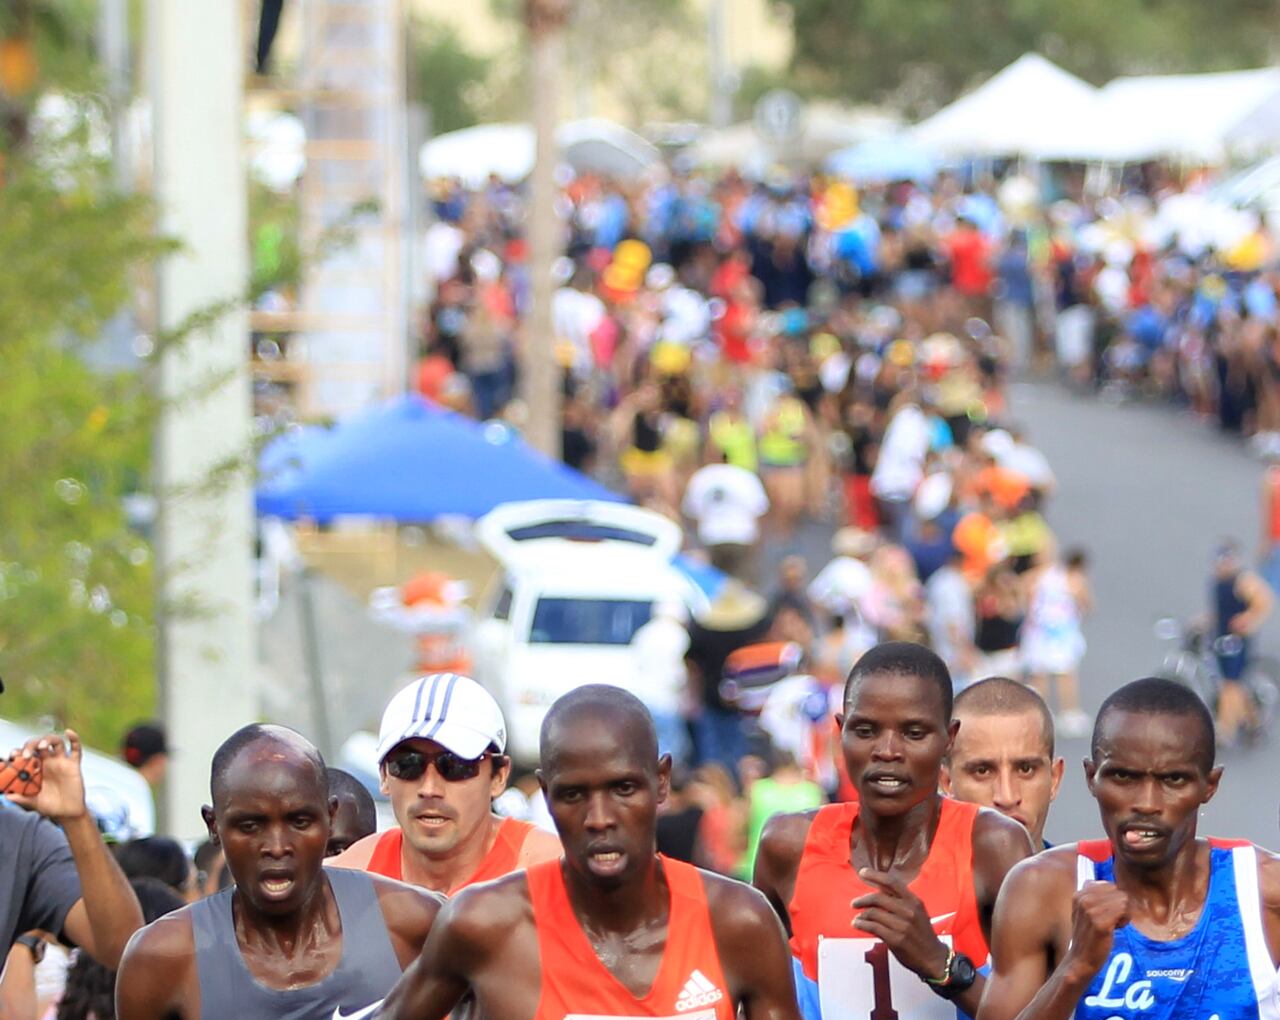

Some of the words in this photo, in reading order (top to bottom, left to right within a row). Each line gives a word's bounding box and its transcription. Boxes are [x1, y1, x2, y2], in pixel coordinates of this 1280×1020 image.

[1085, 953, 1154, 1009] La
[1147, 969, 1186, 978] saucony
[675, 989, 722, 1011] adidas
